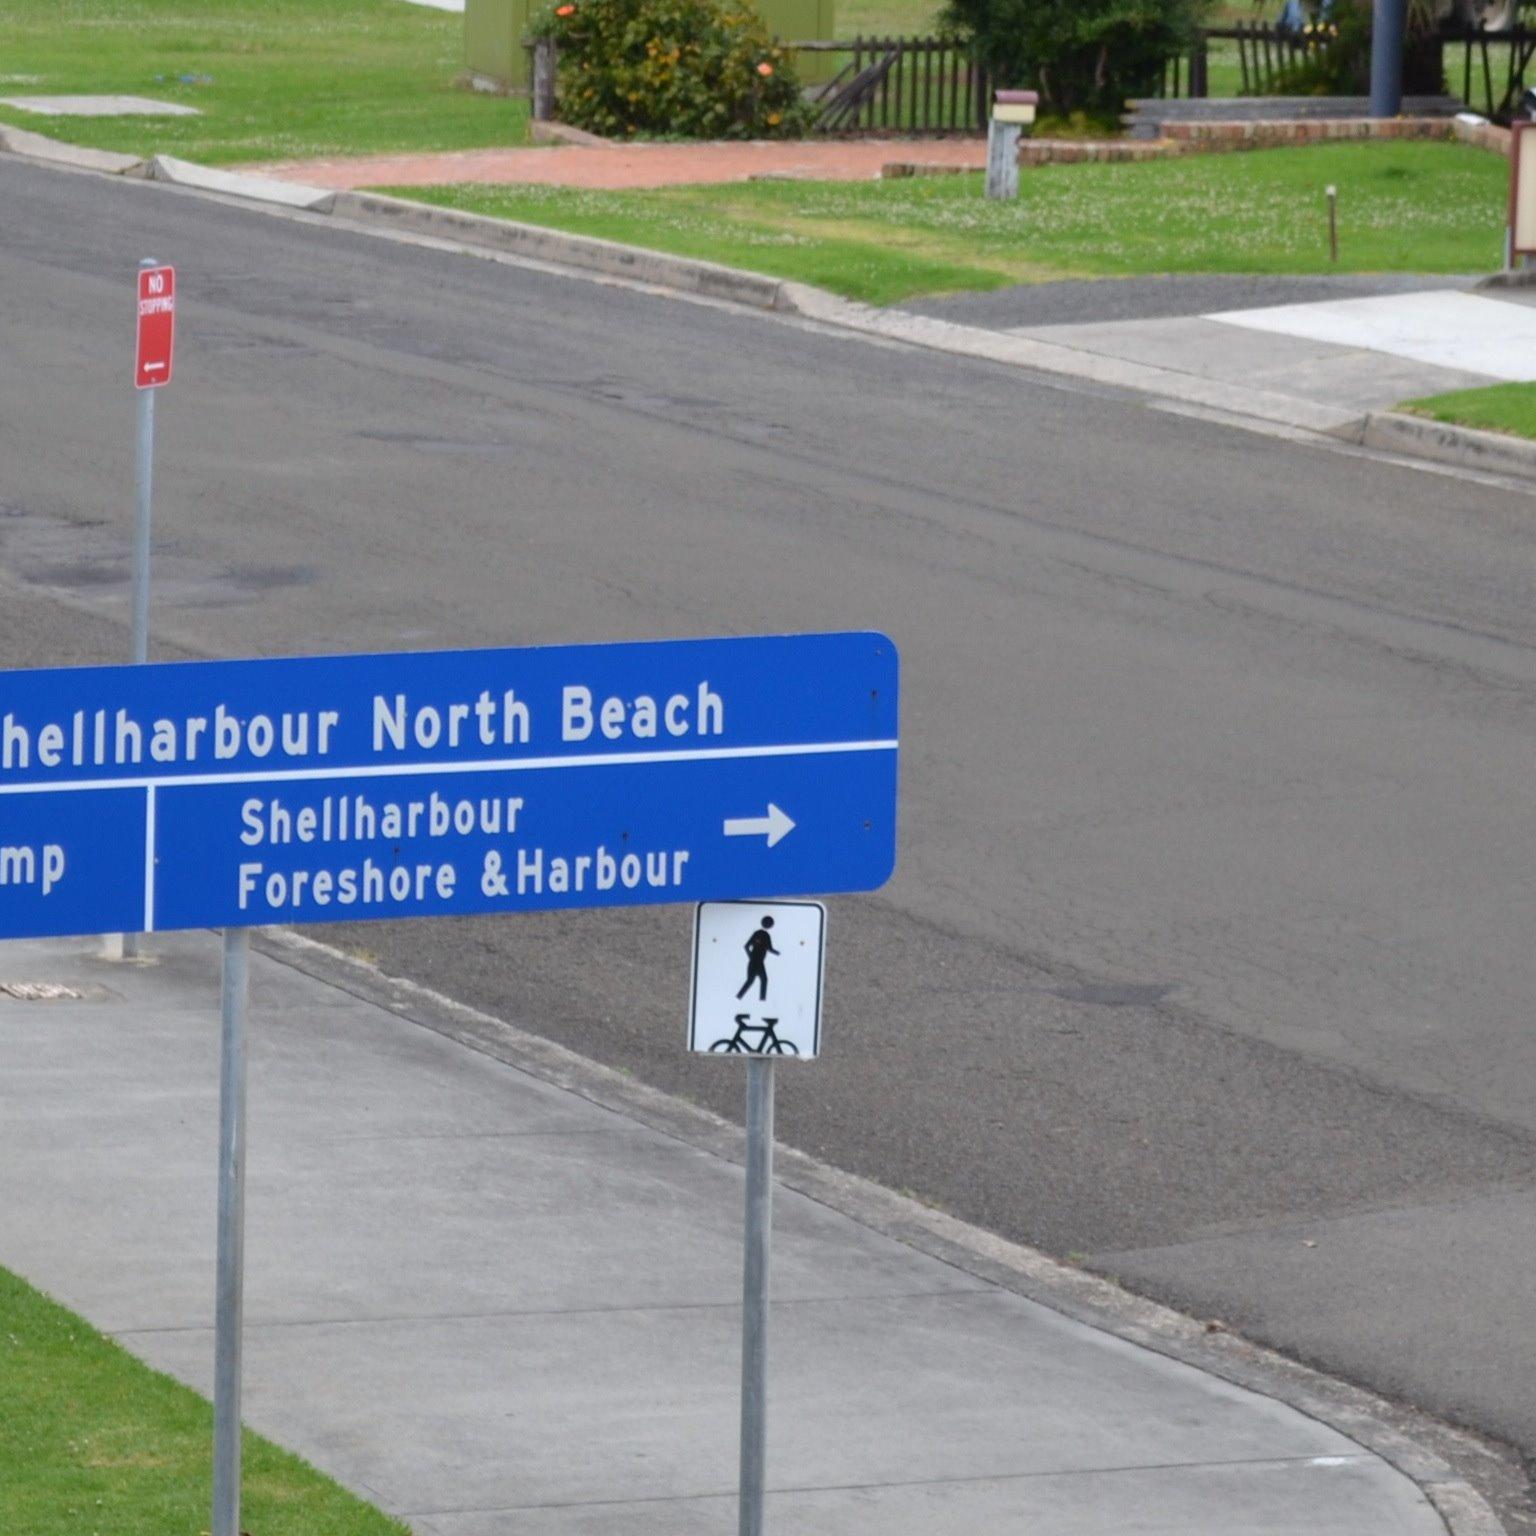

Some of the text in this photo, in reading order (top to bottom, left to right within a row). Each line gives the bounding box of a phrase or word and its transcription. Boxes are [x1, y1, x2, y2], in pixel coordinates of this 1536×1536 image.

[139, 296, 174, 316] STOPPING
[148, 274, 164, 295] NO
[372, 688, 531, 752] North
[561, 679, 725, 742] Beach
[238, 790, 525, 847] Shellharbour
[237, 857, 457, 910] Foreshore
